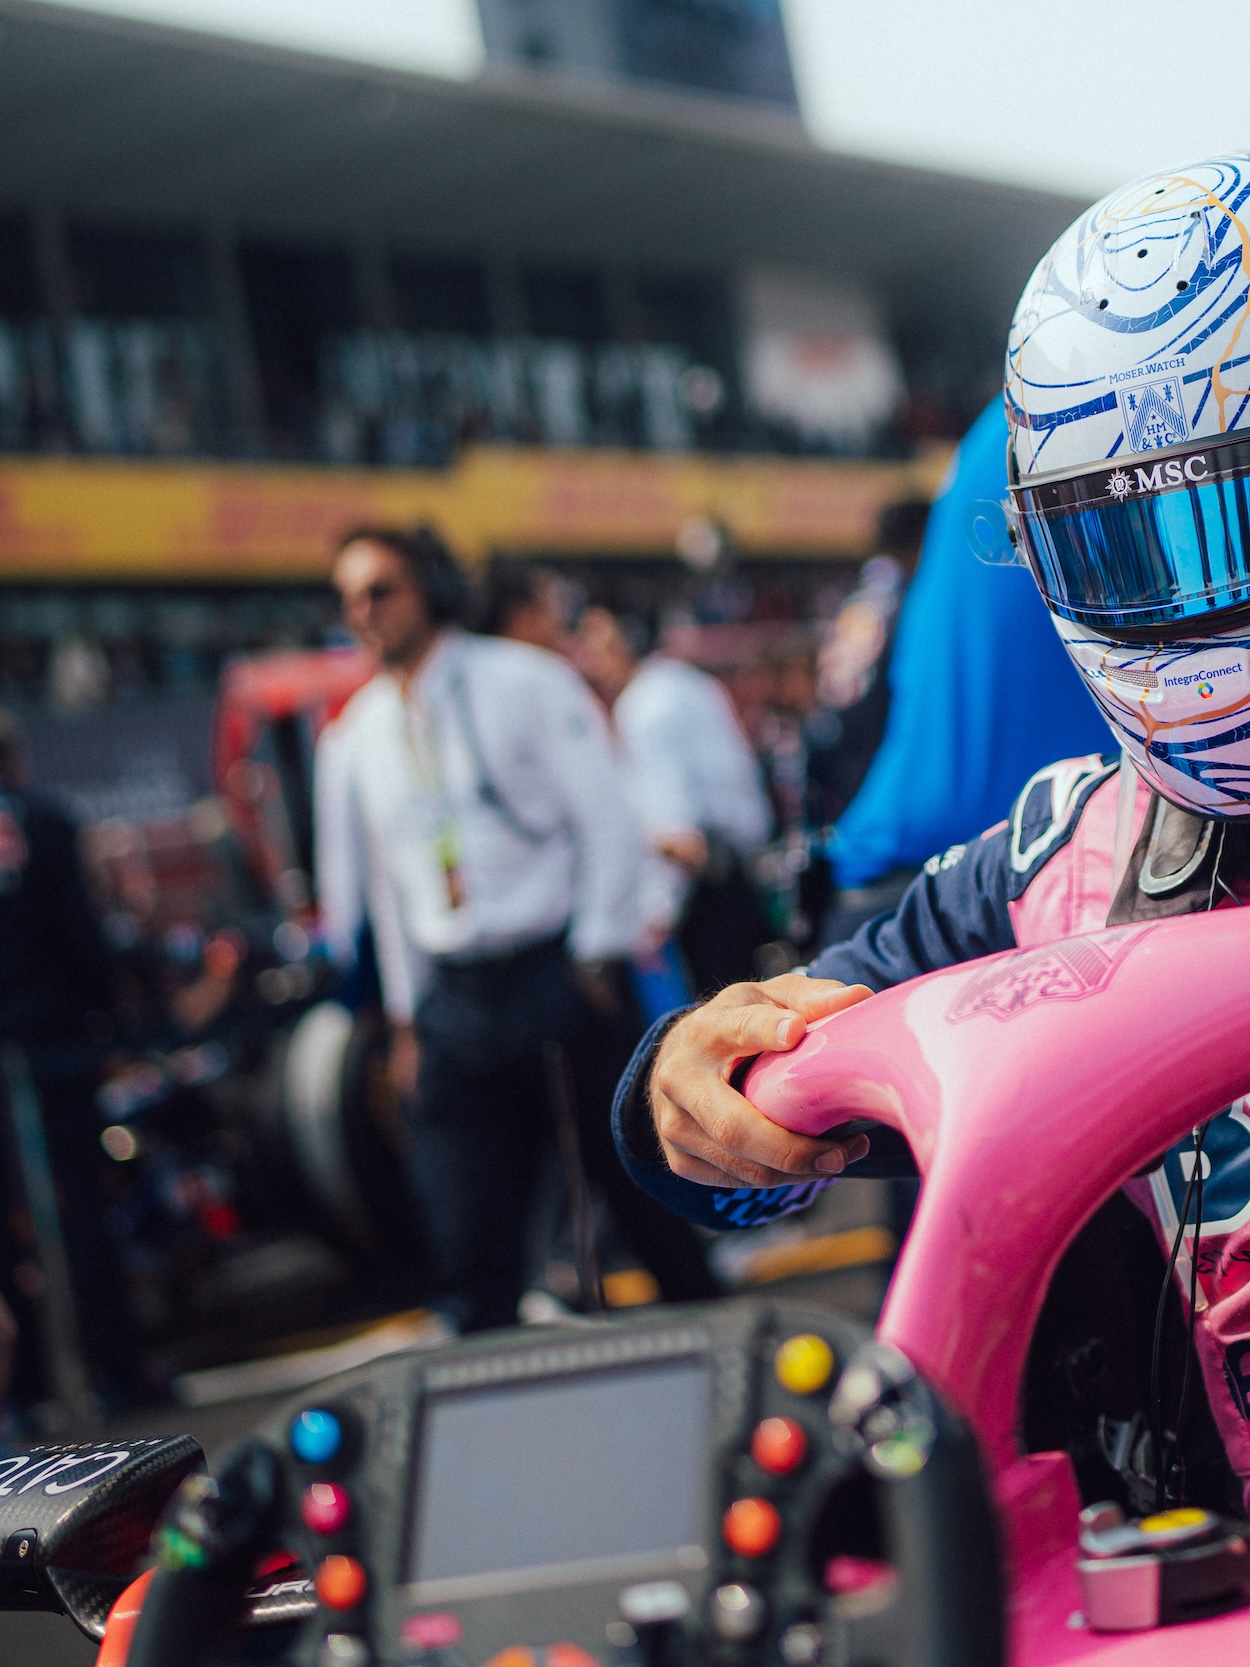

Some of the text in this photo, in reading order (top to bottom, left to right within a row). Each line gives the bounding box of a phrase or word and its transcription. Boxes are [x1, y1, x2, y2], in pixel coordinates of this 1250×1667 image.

[1145, 422, 1167, 435] HM
[1134, 455, 1209, 493] MSC
[1164, 662, 1243, 687] IntegraConnect
